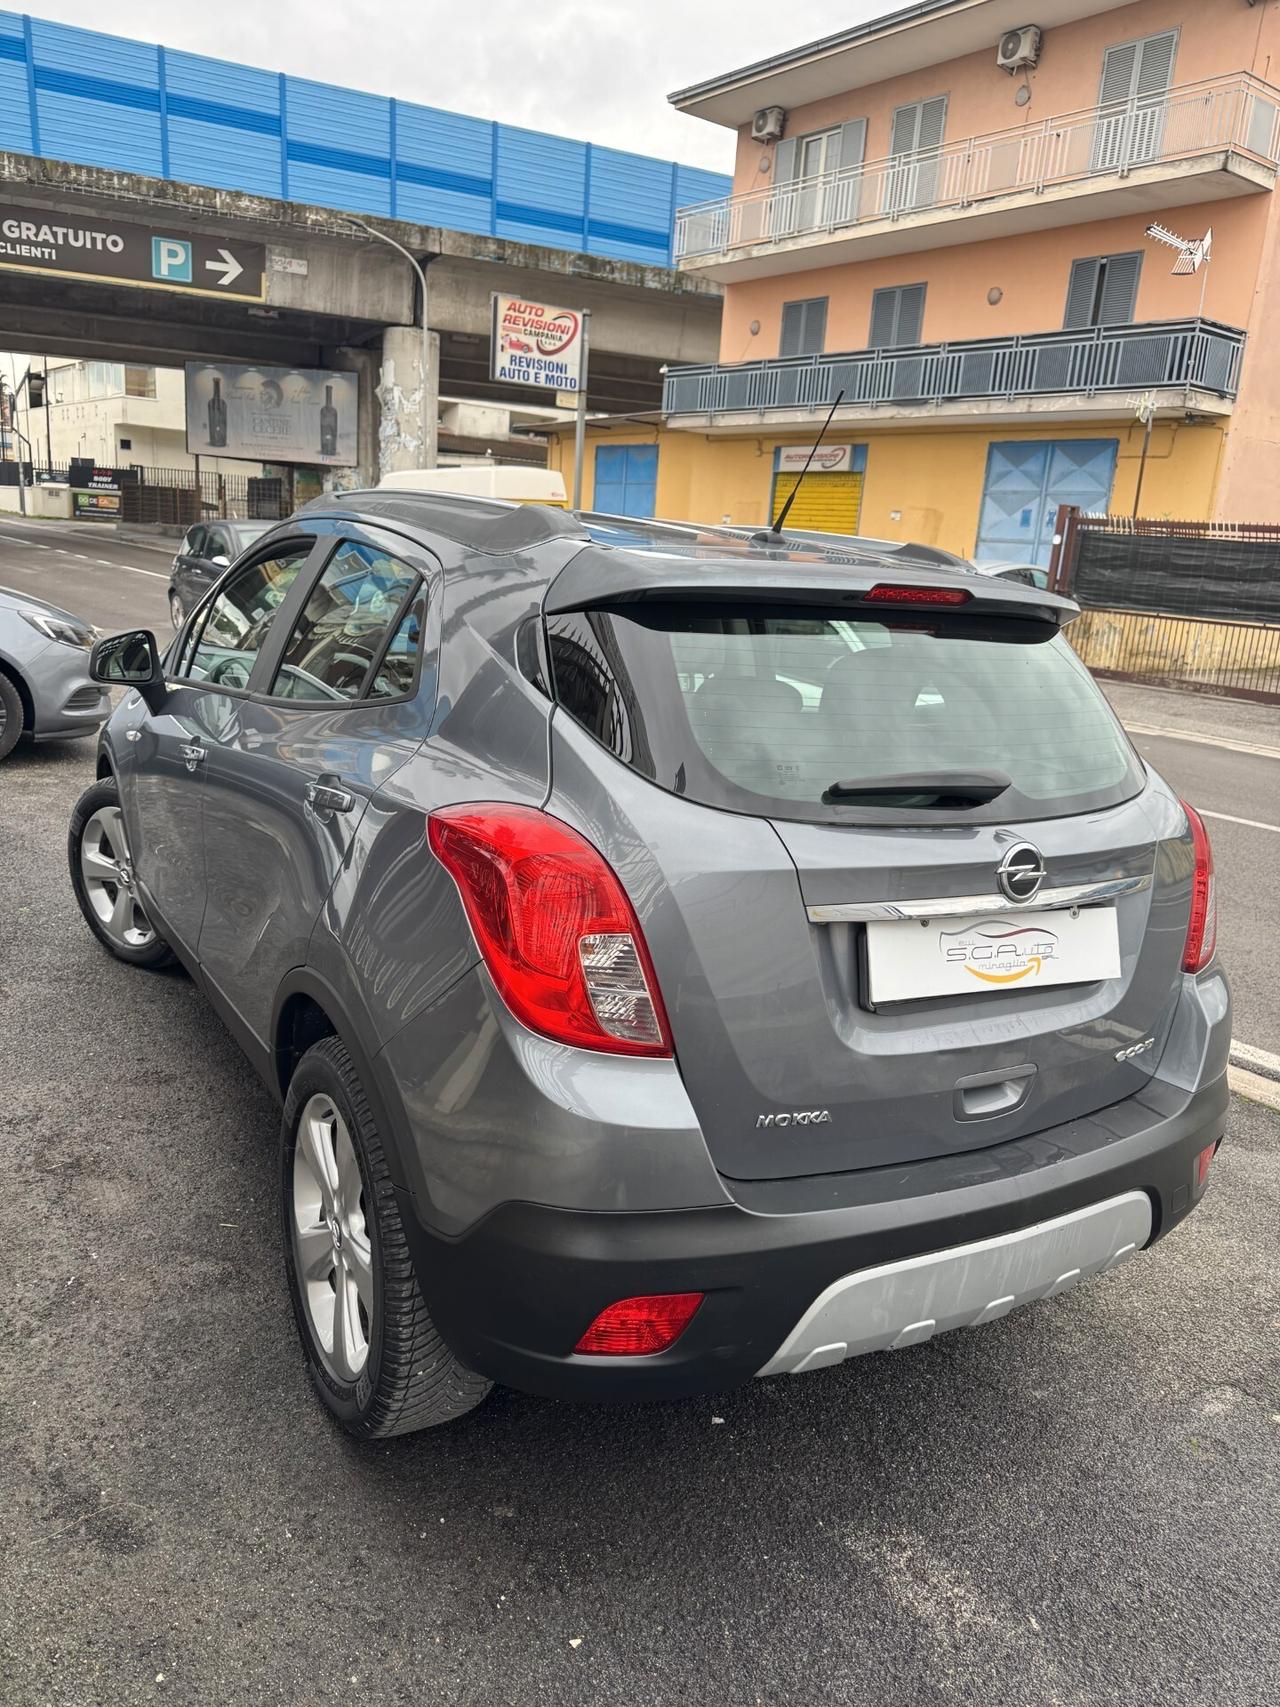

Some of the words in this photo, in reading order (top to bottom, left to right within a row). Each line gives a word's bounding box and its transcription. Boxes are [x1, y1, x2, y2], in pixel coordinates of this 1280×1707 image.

[2, 219, 125, 253] GRATUITO
[0, 241, 57, 260] CLIENTI
[159, 241, 187, 275] P
[507, 302, 545, 317] AUTO
[503, 313, 571, 335] REVISIONI
[523, 328, 563, 342] CAMPANIA
[510, 354, 568, 375] REVISIONI
[499, 366, 530, 382] AUTO
[534, 372, 541, 384] E
[544, 374, 577, 390] MOTO
[755, 1110, 833, 1128] MOKKA
